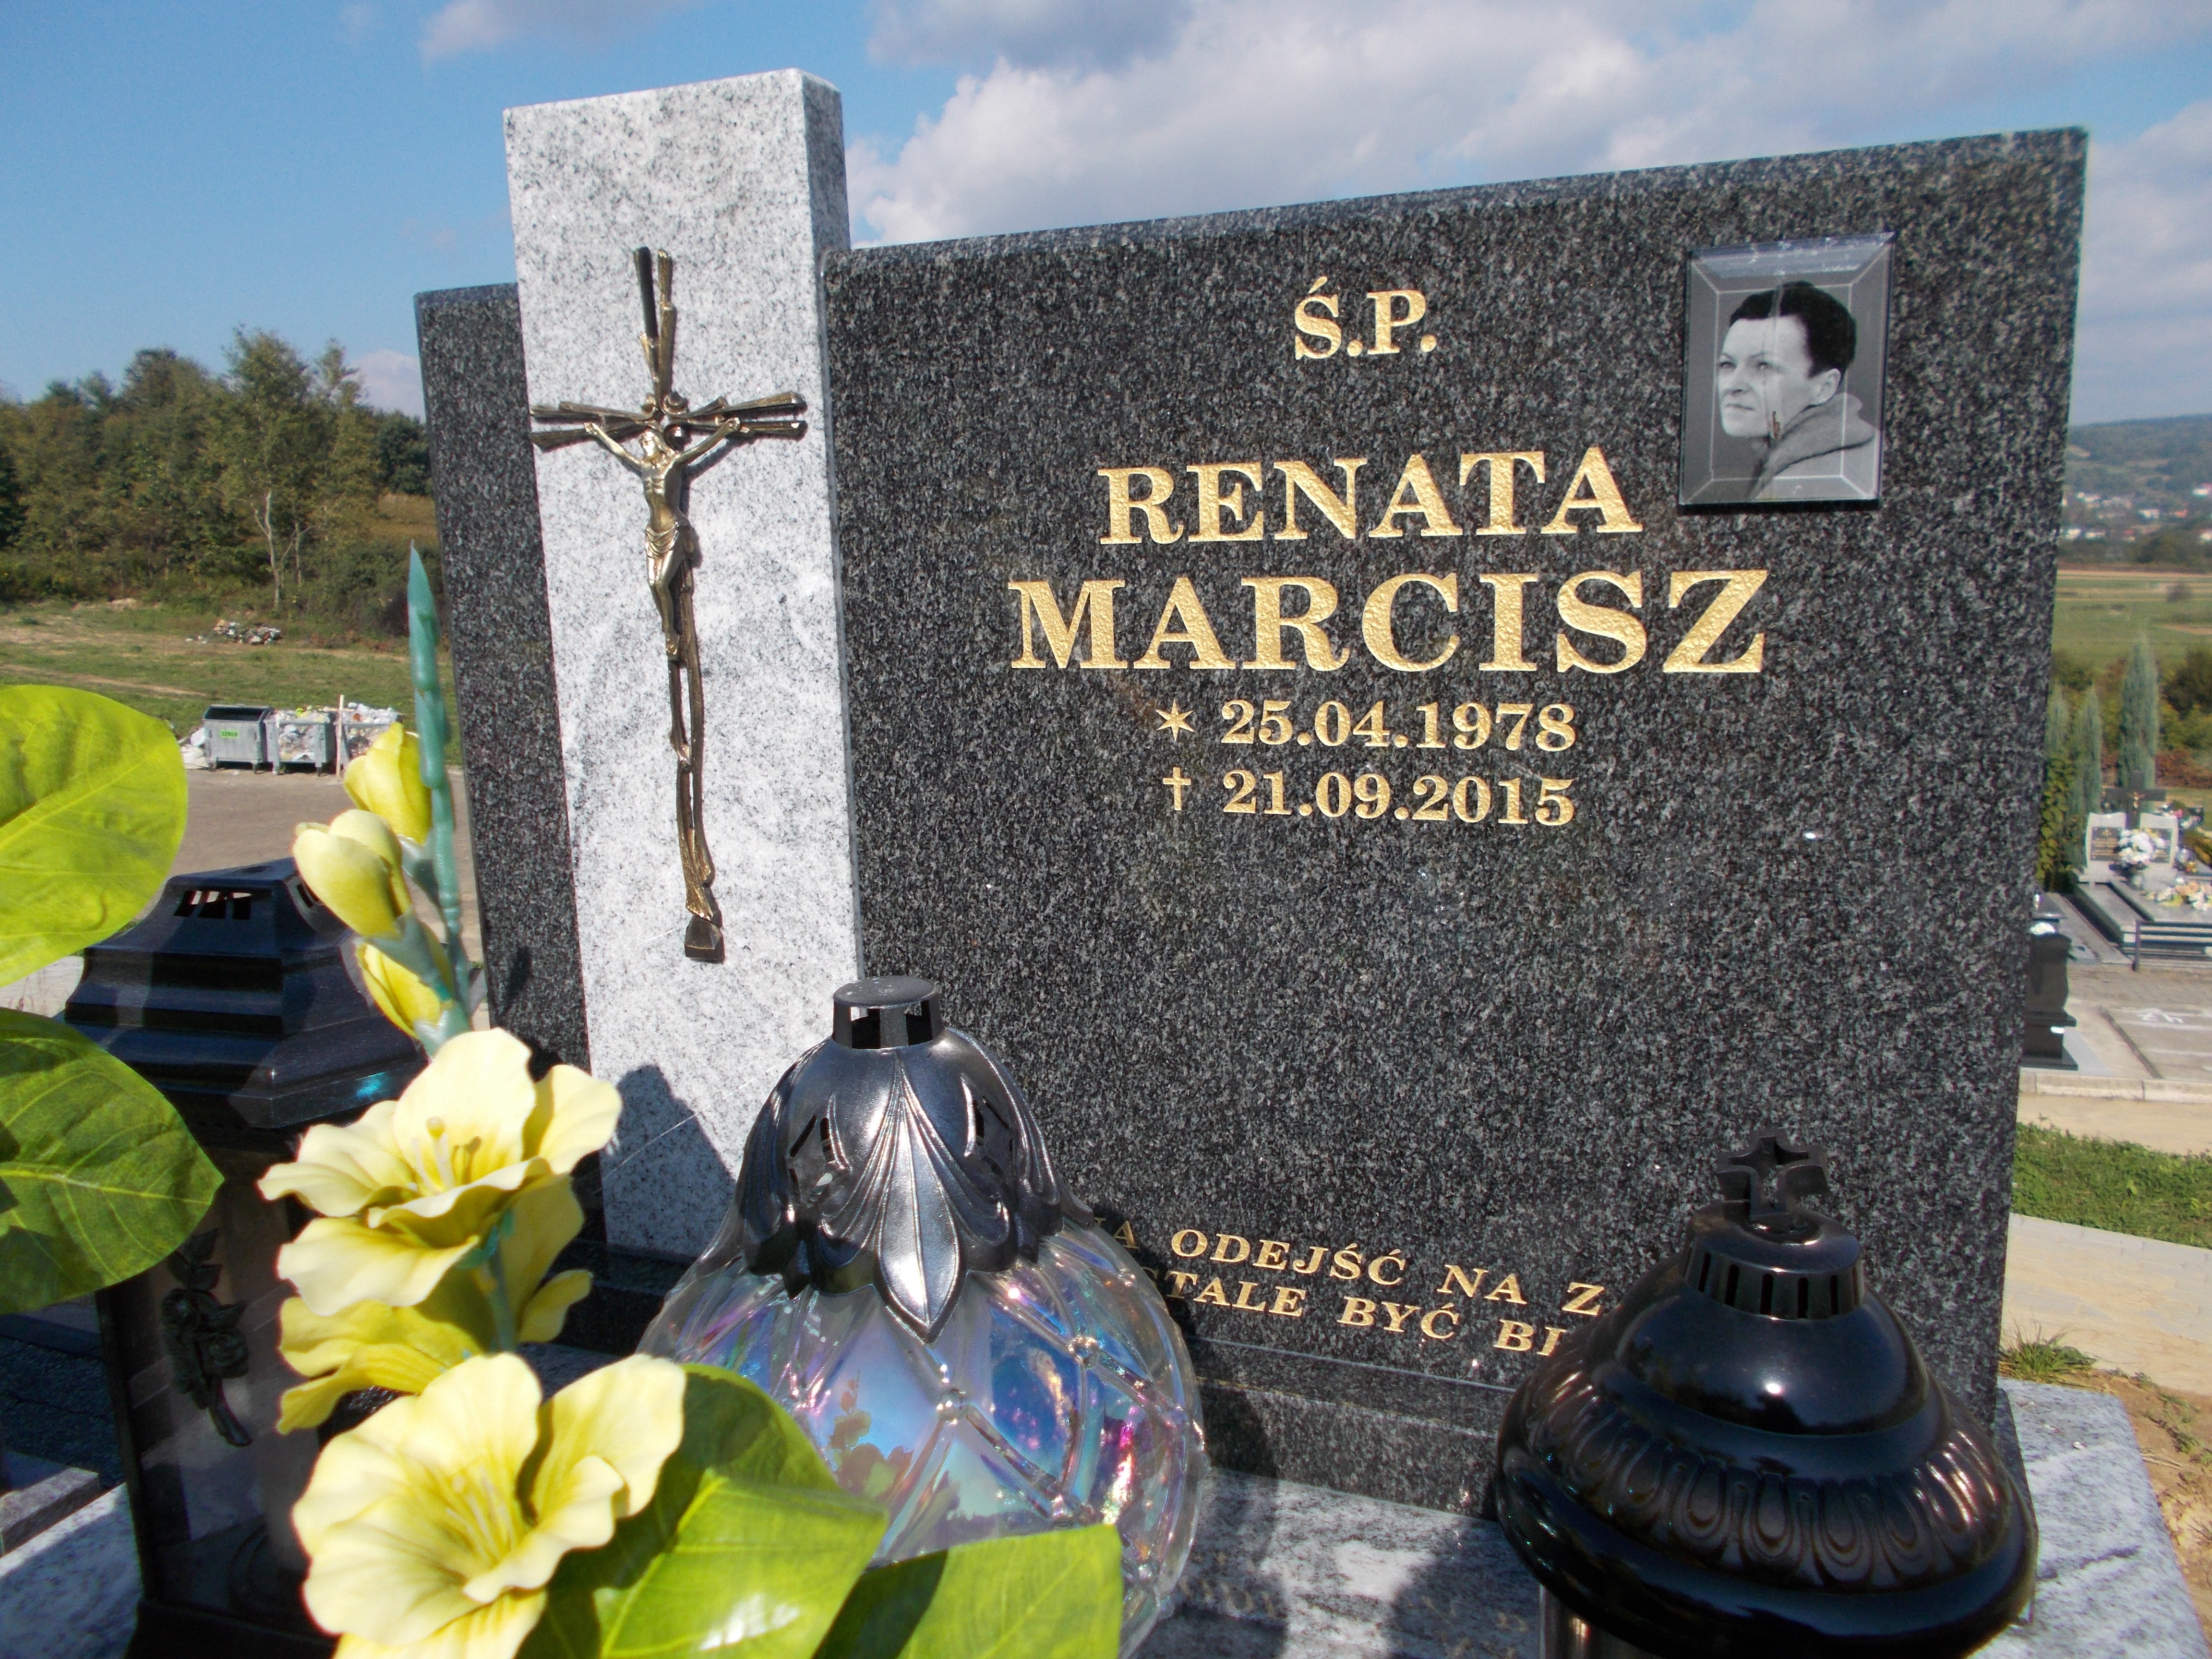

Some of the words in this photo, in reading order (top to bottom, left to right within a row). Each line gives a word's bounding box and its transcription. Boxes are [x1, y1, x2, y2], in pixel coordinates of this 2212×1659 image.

[1295, 275, 1437, 360] Ś.P.
[1097, 446, 1644, 544] RENATA
[1008, 569, 1768, 673] MARCISZ
[1221, 698, 1576, 751] 25.04.1978
[1222, 769, 1576, 826] 21.09.2015
[1171, 1229, 1407, 1287] ODEJŚĆ
[1436, 1264, 1528, 1306] NA
[1337, 1296, 1461, 1340] BYĆ
